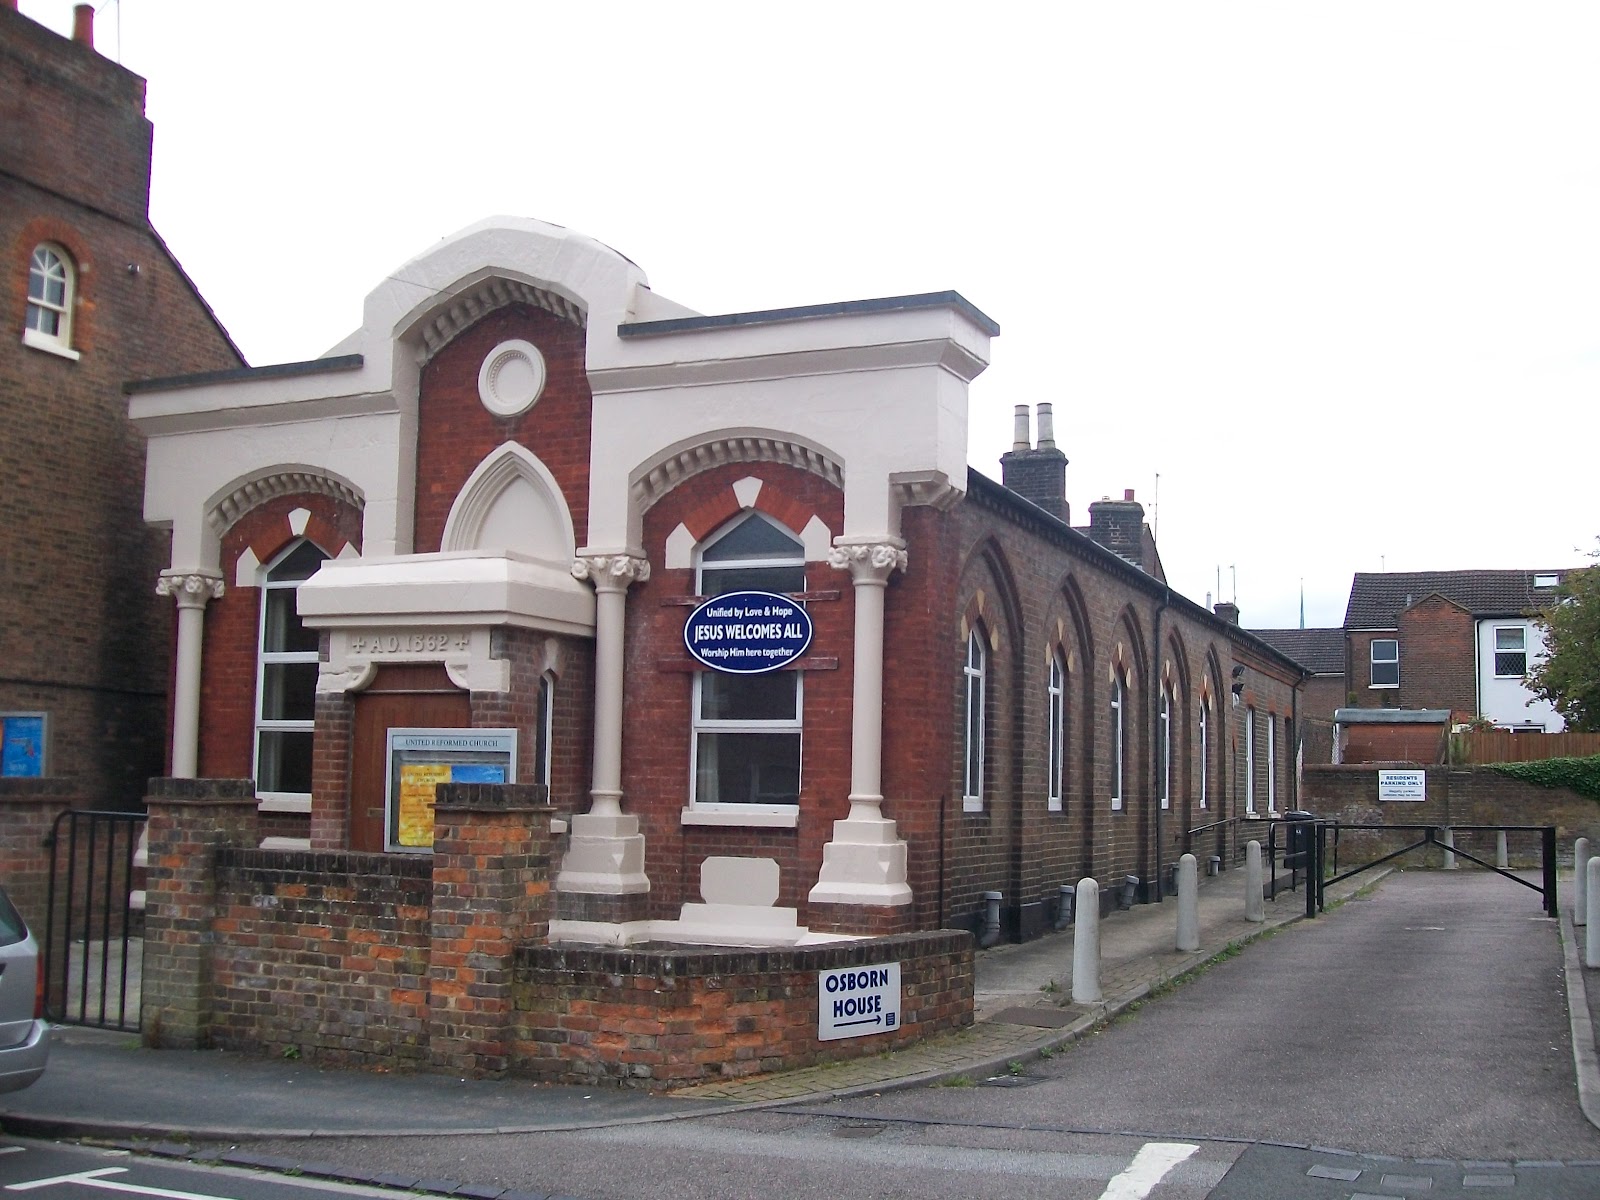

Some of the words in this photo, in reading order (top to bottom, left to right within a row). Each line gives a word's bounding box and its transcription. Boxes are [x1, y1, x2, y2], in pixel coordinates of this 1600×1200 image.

[706, 607, 733, 618] Unified
[734, 606, 743, 619] by
[744, 607, 762, 617] Love
[763, 606, 771, 616] &
[772, 606, 793, 618] Hope
[694, 624, 723, 644] JESUS
[725, 623, 782, 640] WELCOMES
[783, 623, 803, 639] ALL
[700, 648, 729, 660] Worship
[730, 647, 745, 657] Him
[745, 647, 762, 657] here
[762, 647, 794, 659] together
[432, 739, 467, 747] REFORMED
[469, 739, 498, 747] CHURCH
[825, 969, 888, 993] OSBORN
[833, 995, 881, 1018] HOUSE
